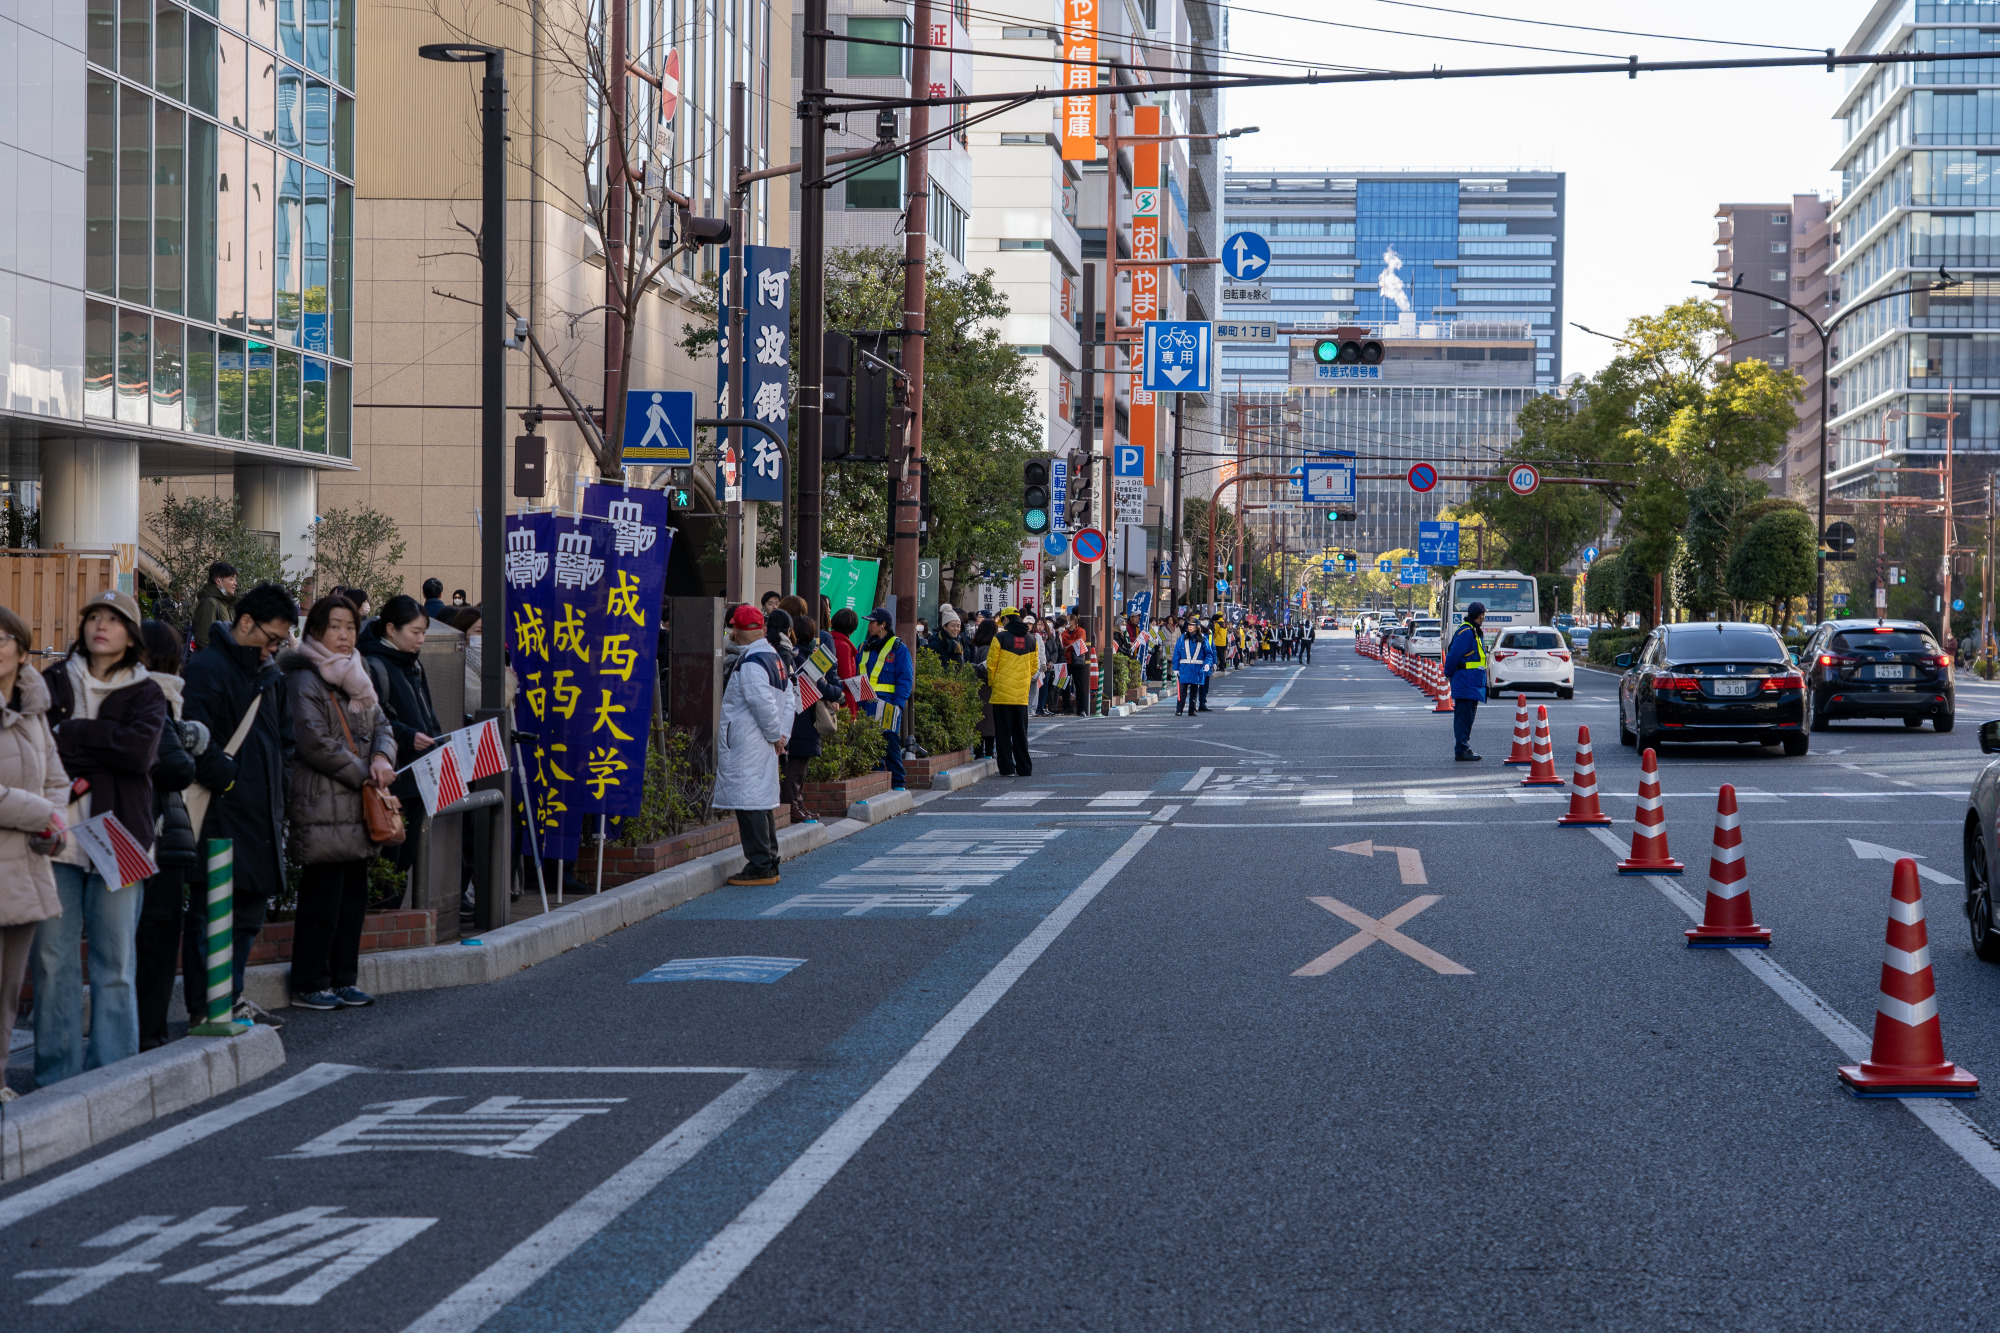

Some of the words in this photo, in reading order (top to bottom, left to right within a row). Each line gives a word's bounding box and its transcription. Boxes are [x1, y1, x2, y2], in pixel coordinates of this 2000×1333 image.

[1223, 289, 1268, 300] 自転車を除く
[752, 267, 789, 480] 阿波銀行
[1319, 366, 1379, 378] 時差式信号機
[1121, 449, 1139, 474] P
[1515, 472, 1533, 486] 40
[1053, 463, 1067, 529] 自転車専用
